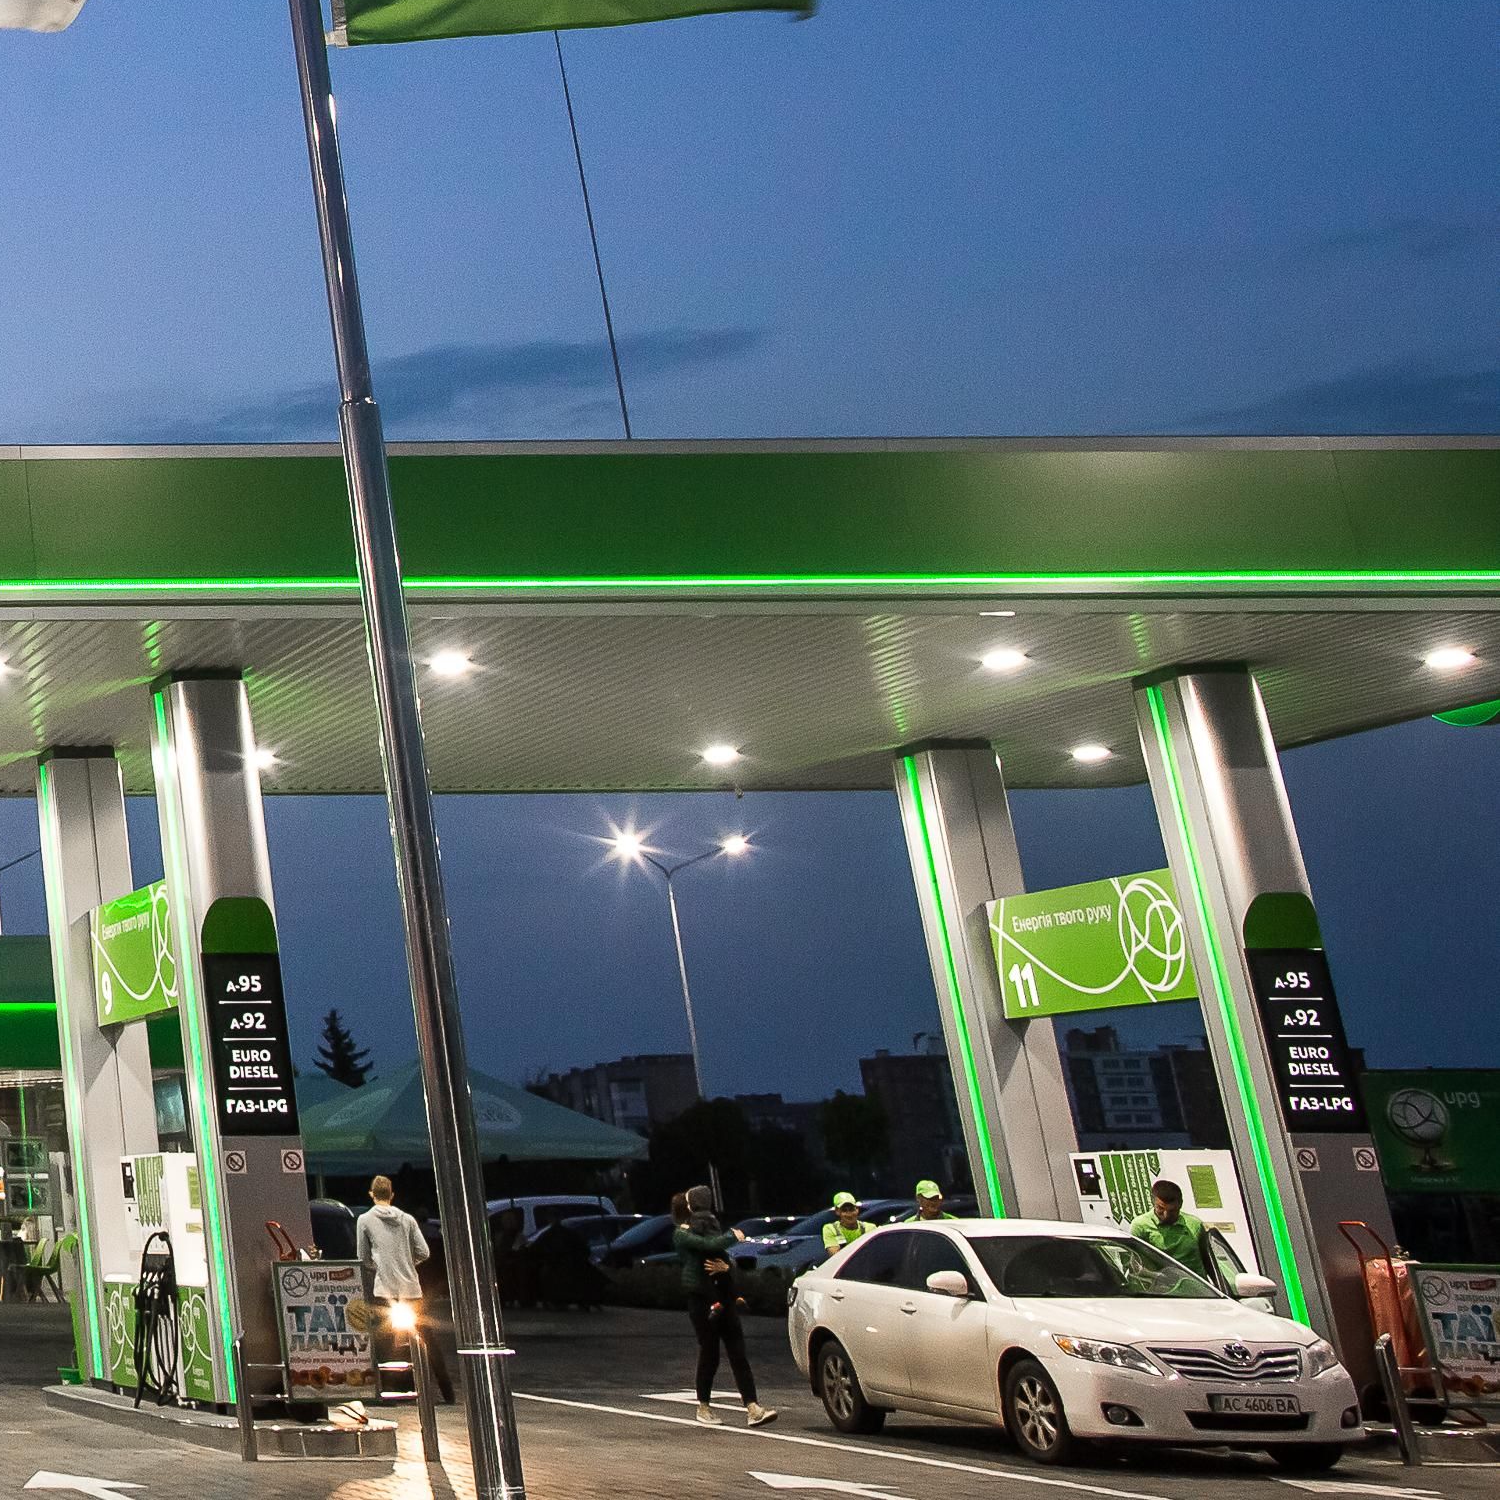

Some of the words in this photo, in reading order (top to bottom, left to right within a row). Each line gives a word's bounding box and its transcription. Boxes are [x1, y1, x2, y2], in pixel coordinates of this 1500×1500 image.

[1012, 911, 1052, 933] Енергія
[1053, 911, 1084, 926] твого
[1087, 903, 1112, 924] руху
[226, 976, 261, 992] A-95
[1008, 962, 1040, 1008] 11
[1275, 972, 1310, 988] A-95
[101, 971, 113, 1016] 9
[230, 1013, 266, 1029] A-92
[1284, 1009, 1320, 1025] A-92
[232, 1050, 271, 1062] EURO
[1289, 1047, 1329, 1058] EURO
[229, 1066, 278, 1079] DIESEL
[1288, 1063, 1339, 1075] DIESEL
[226, 1099, 288, 1113] ГАЗ-LPG
[1290, 1097, 1353, 1110] ГАЗ-LPG
[1444, 1092, 1481, 1108] upg
[1223, 1398, 1241, 1411] AC
[1245, 1398, 1274, 1412] 4606
[1275, 1399, 1297, 1412] BA
